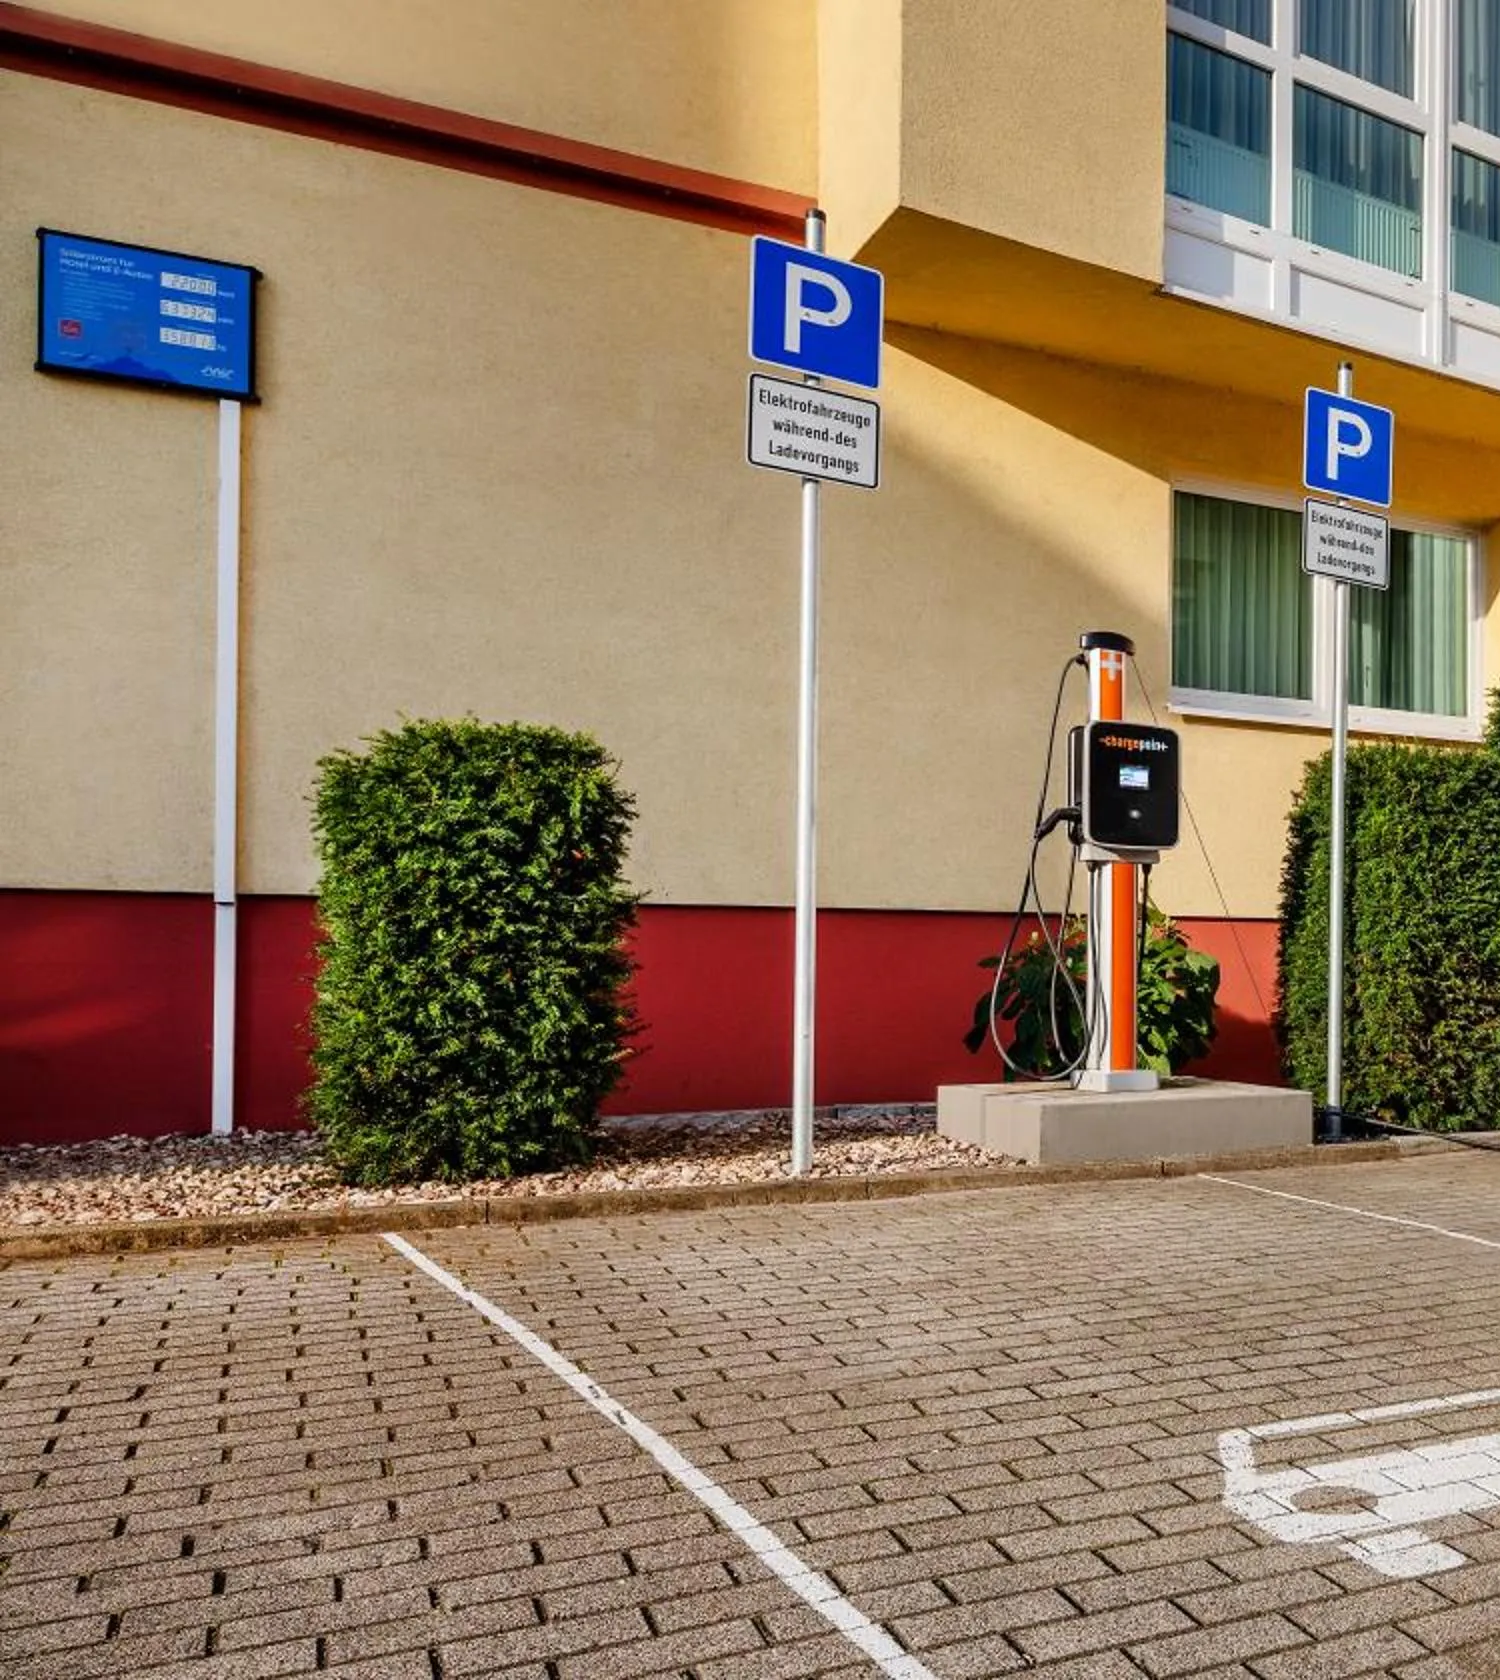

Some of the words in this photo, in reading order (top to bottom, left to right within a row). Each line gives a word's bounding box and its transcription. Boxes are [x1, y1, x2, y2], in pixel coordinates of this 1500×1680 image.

[784, 261, 852, 354] P
[759, 389, 871, 429] Elektrofahrzeuge
[769, 440, 860, 475] Ladevorgangs
[1327, 407, 1373, 480] P
